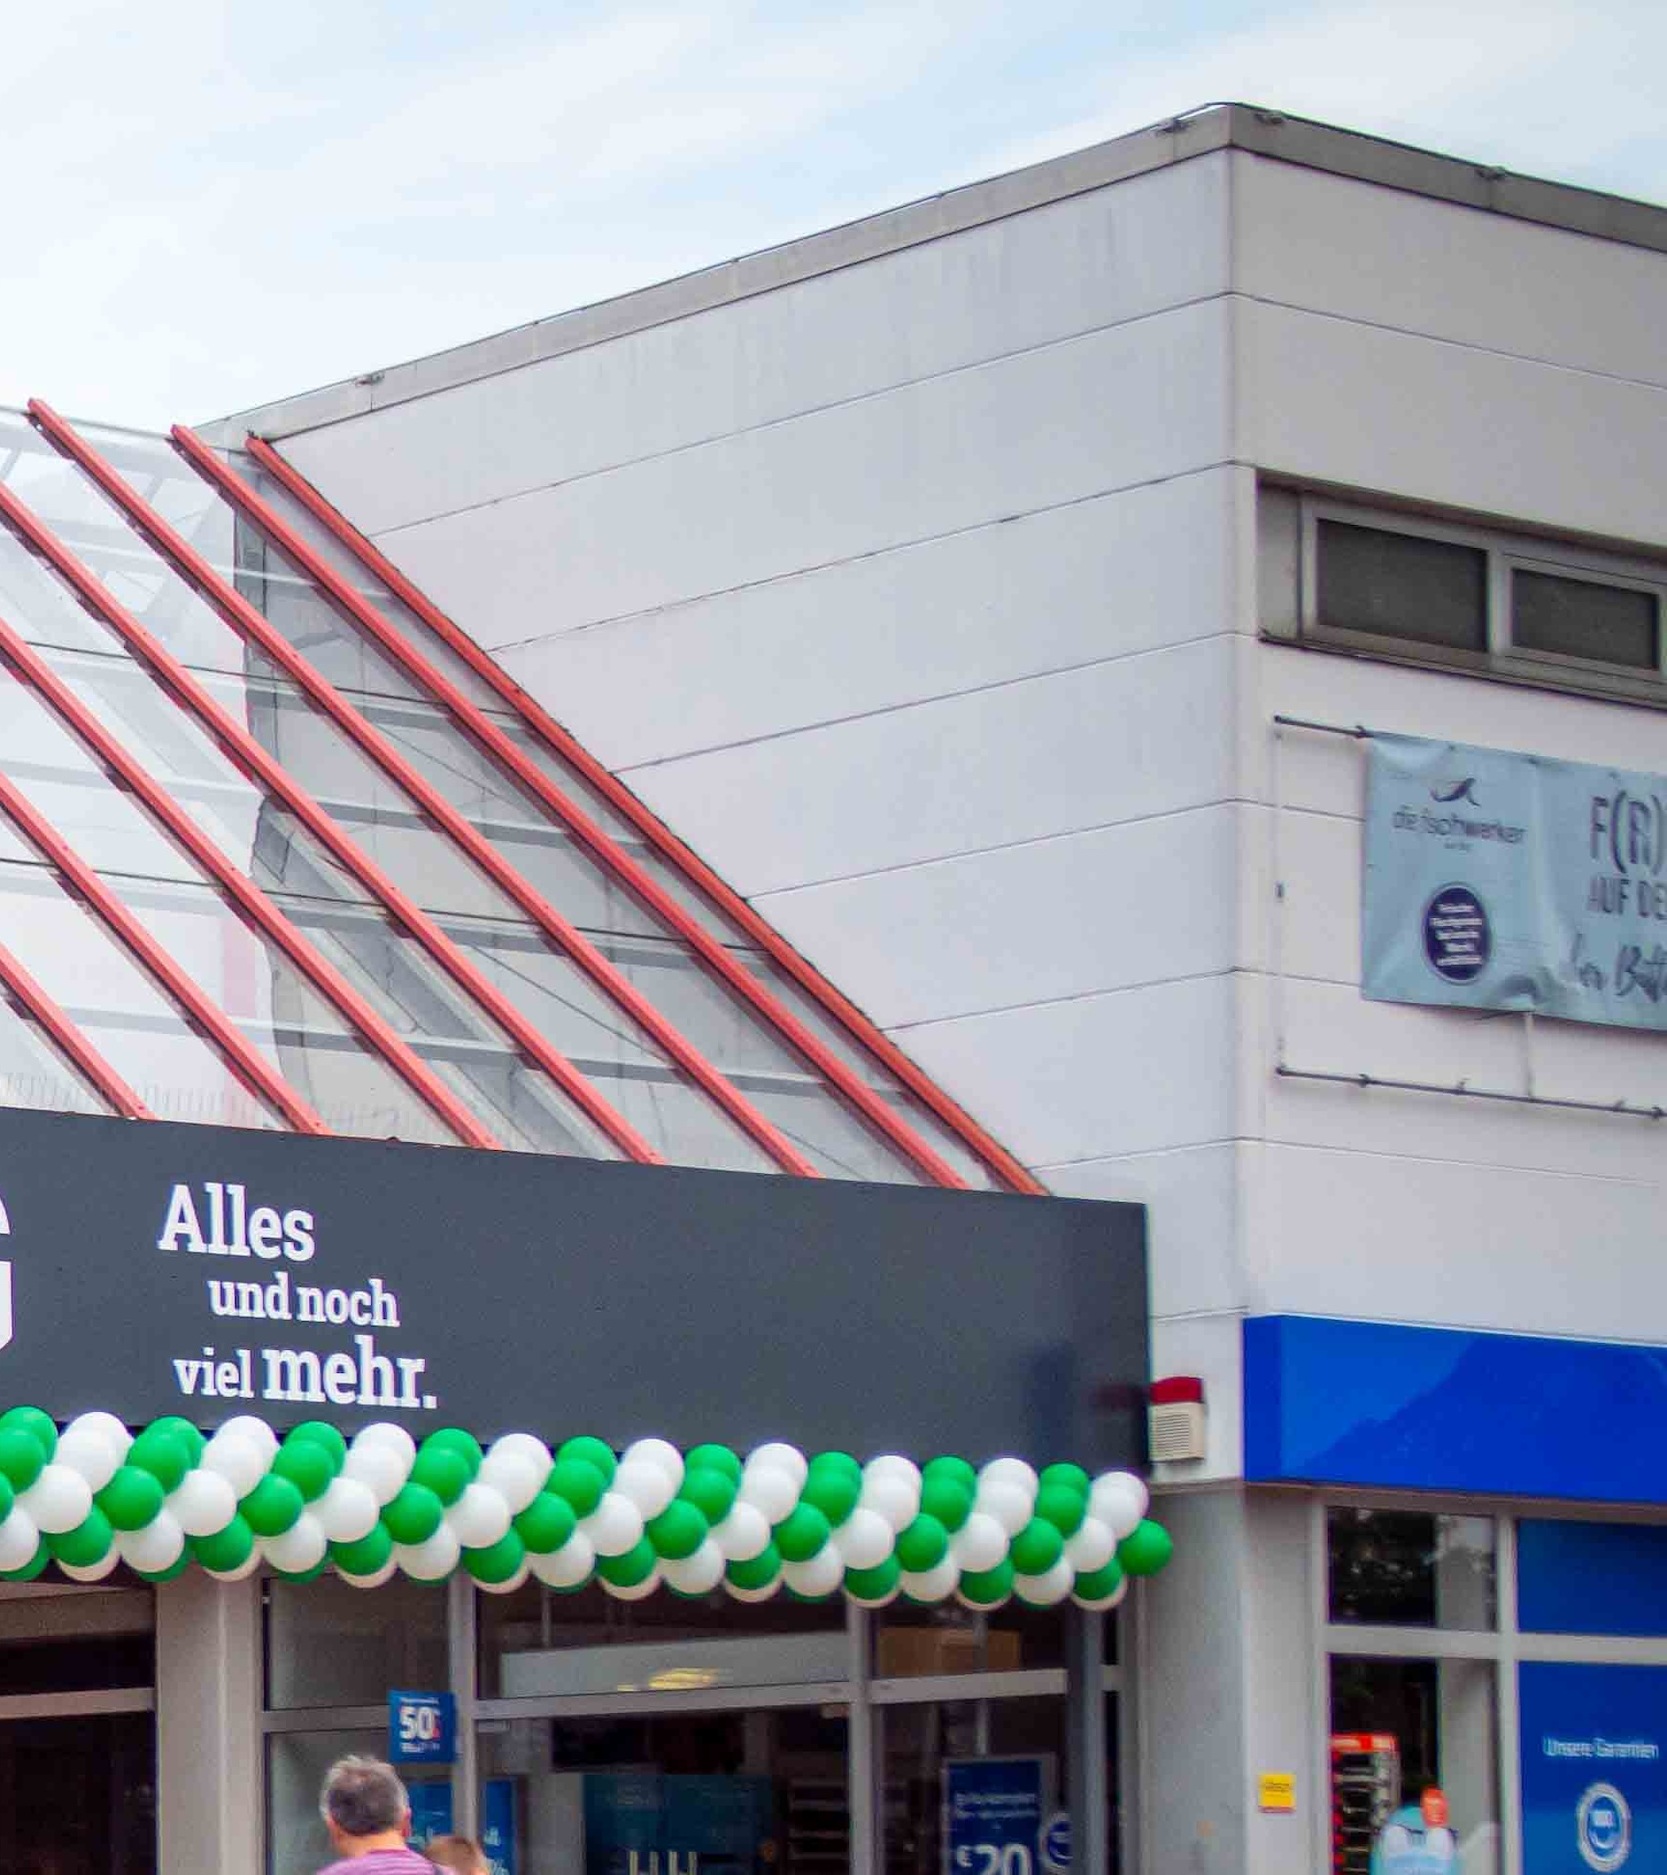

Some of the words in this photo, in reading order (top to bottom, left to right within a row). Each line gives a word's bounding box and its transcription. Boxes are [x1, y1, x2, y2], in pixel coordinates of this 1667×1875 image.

[157, 1181, 315, 1262] Alles
[207, 1271, 292, 1320] und
[296, 1278, 400, 1327] noch
[172, 1347, 255, 1398] viel
[262, 1334, 437, 1409] mehr.
